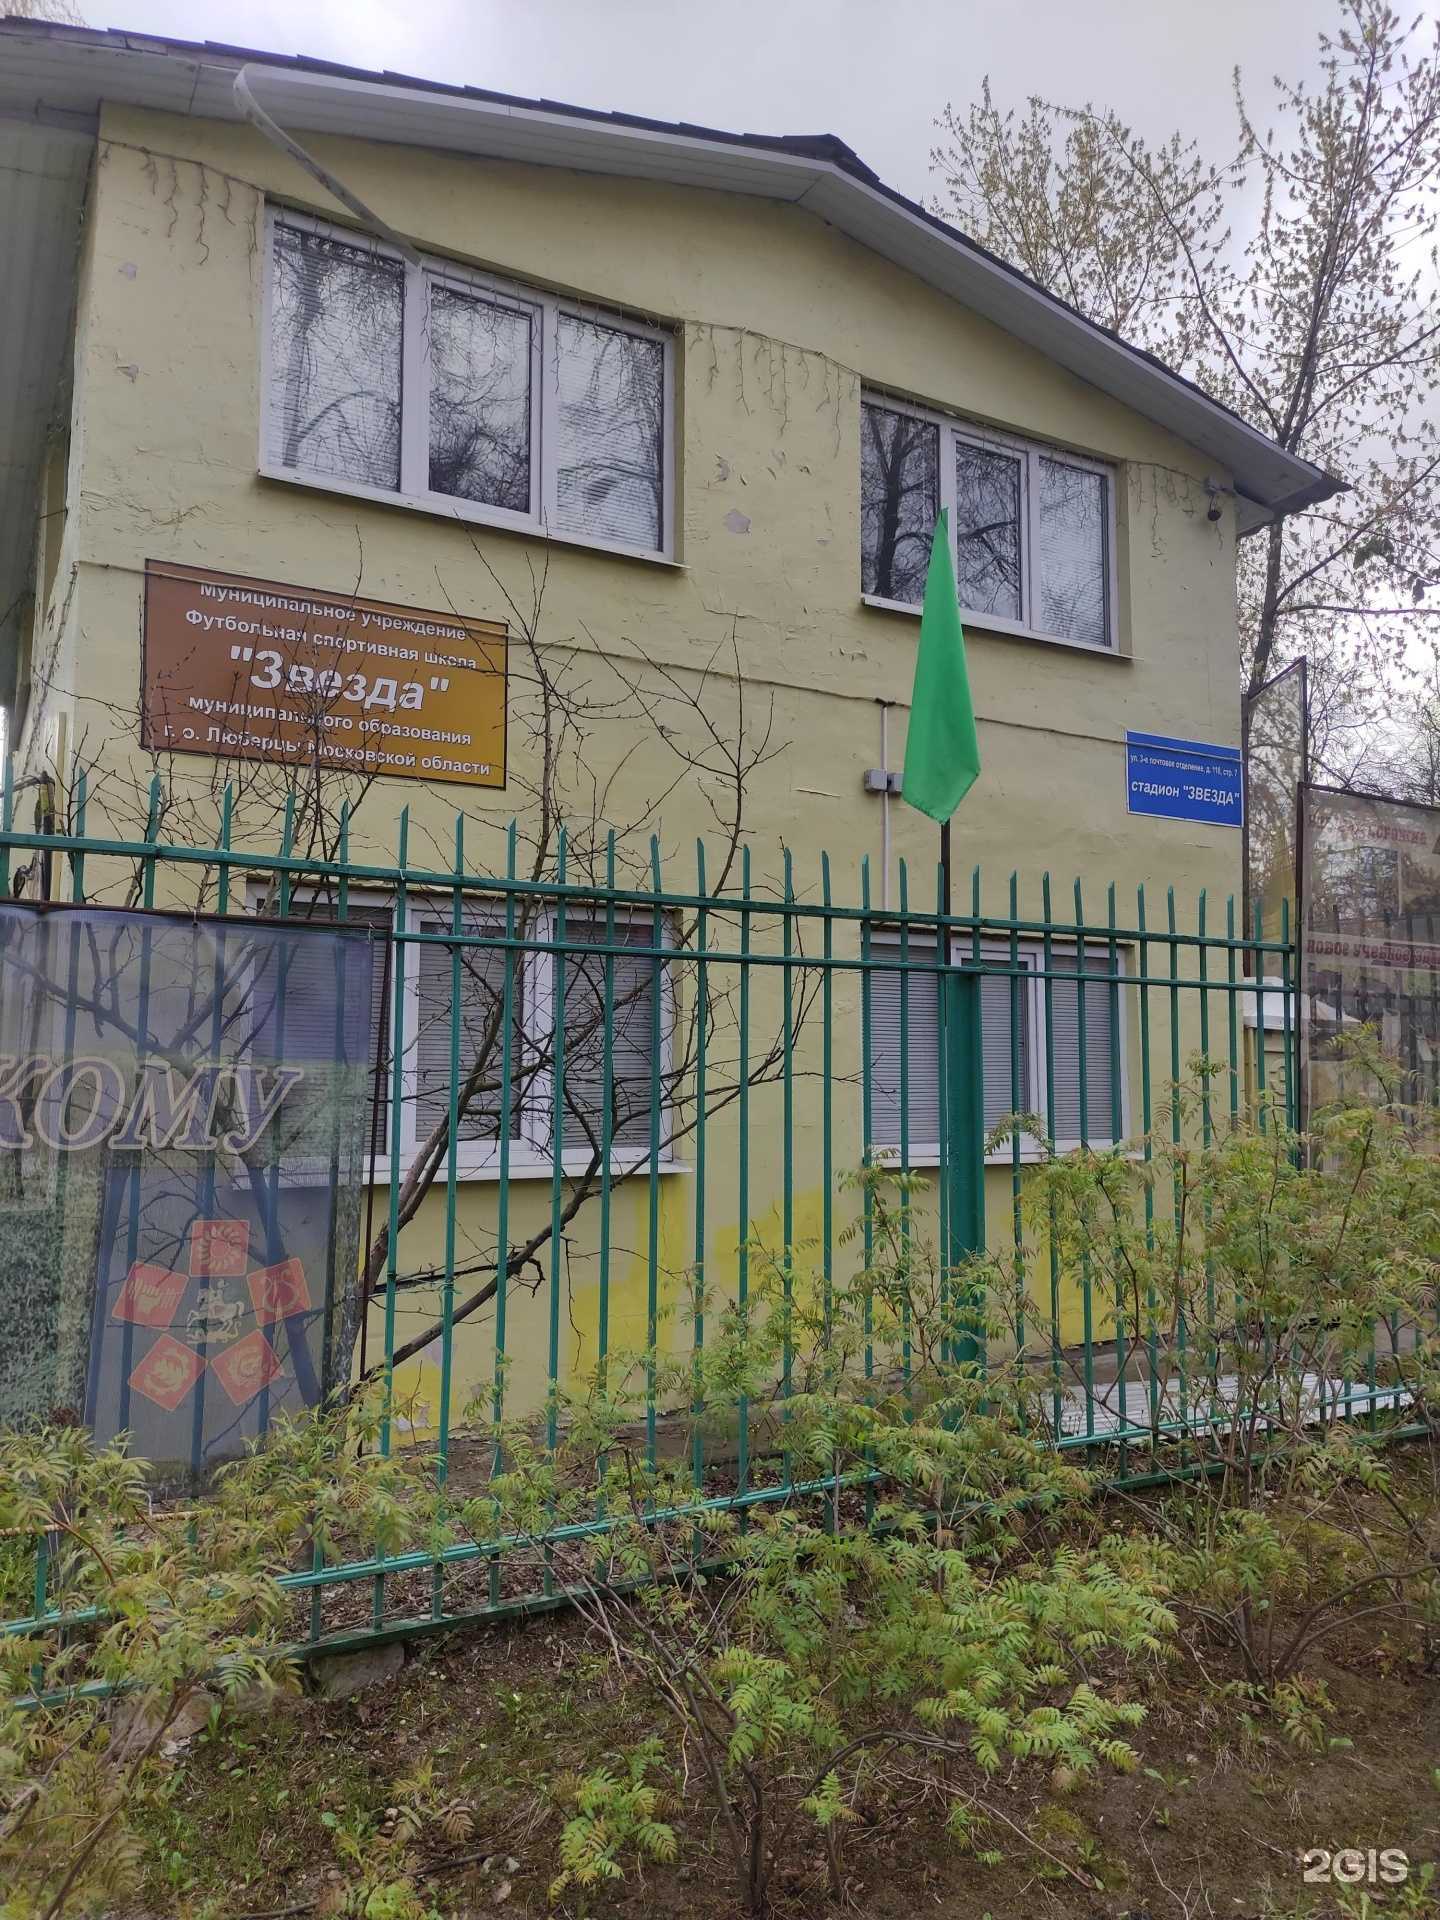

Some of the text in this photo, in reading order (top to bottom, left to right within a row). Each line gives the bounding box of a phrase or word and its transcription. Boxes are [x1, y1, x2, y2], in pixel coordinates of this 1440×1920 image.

[200, 582, 467, 641] Муниципальное учреждение
[185, 609, 477, 670] Футбольная спортивная школа
[229, 645, 450, 712] "Звезда"
[183, 727, 200, 741] о.
[421, 755, 490, 776] области
[358, 719, 472, 746] образования
[1131, 780, 1180, 798] стадион
